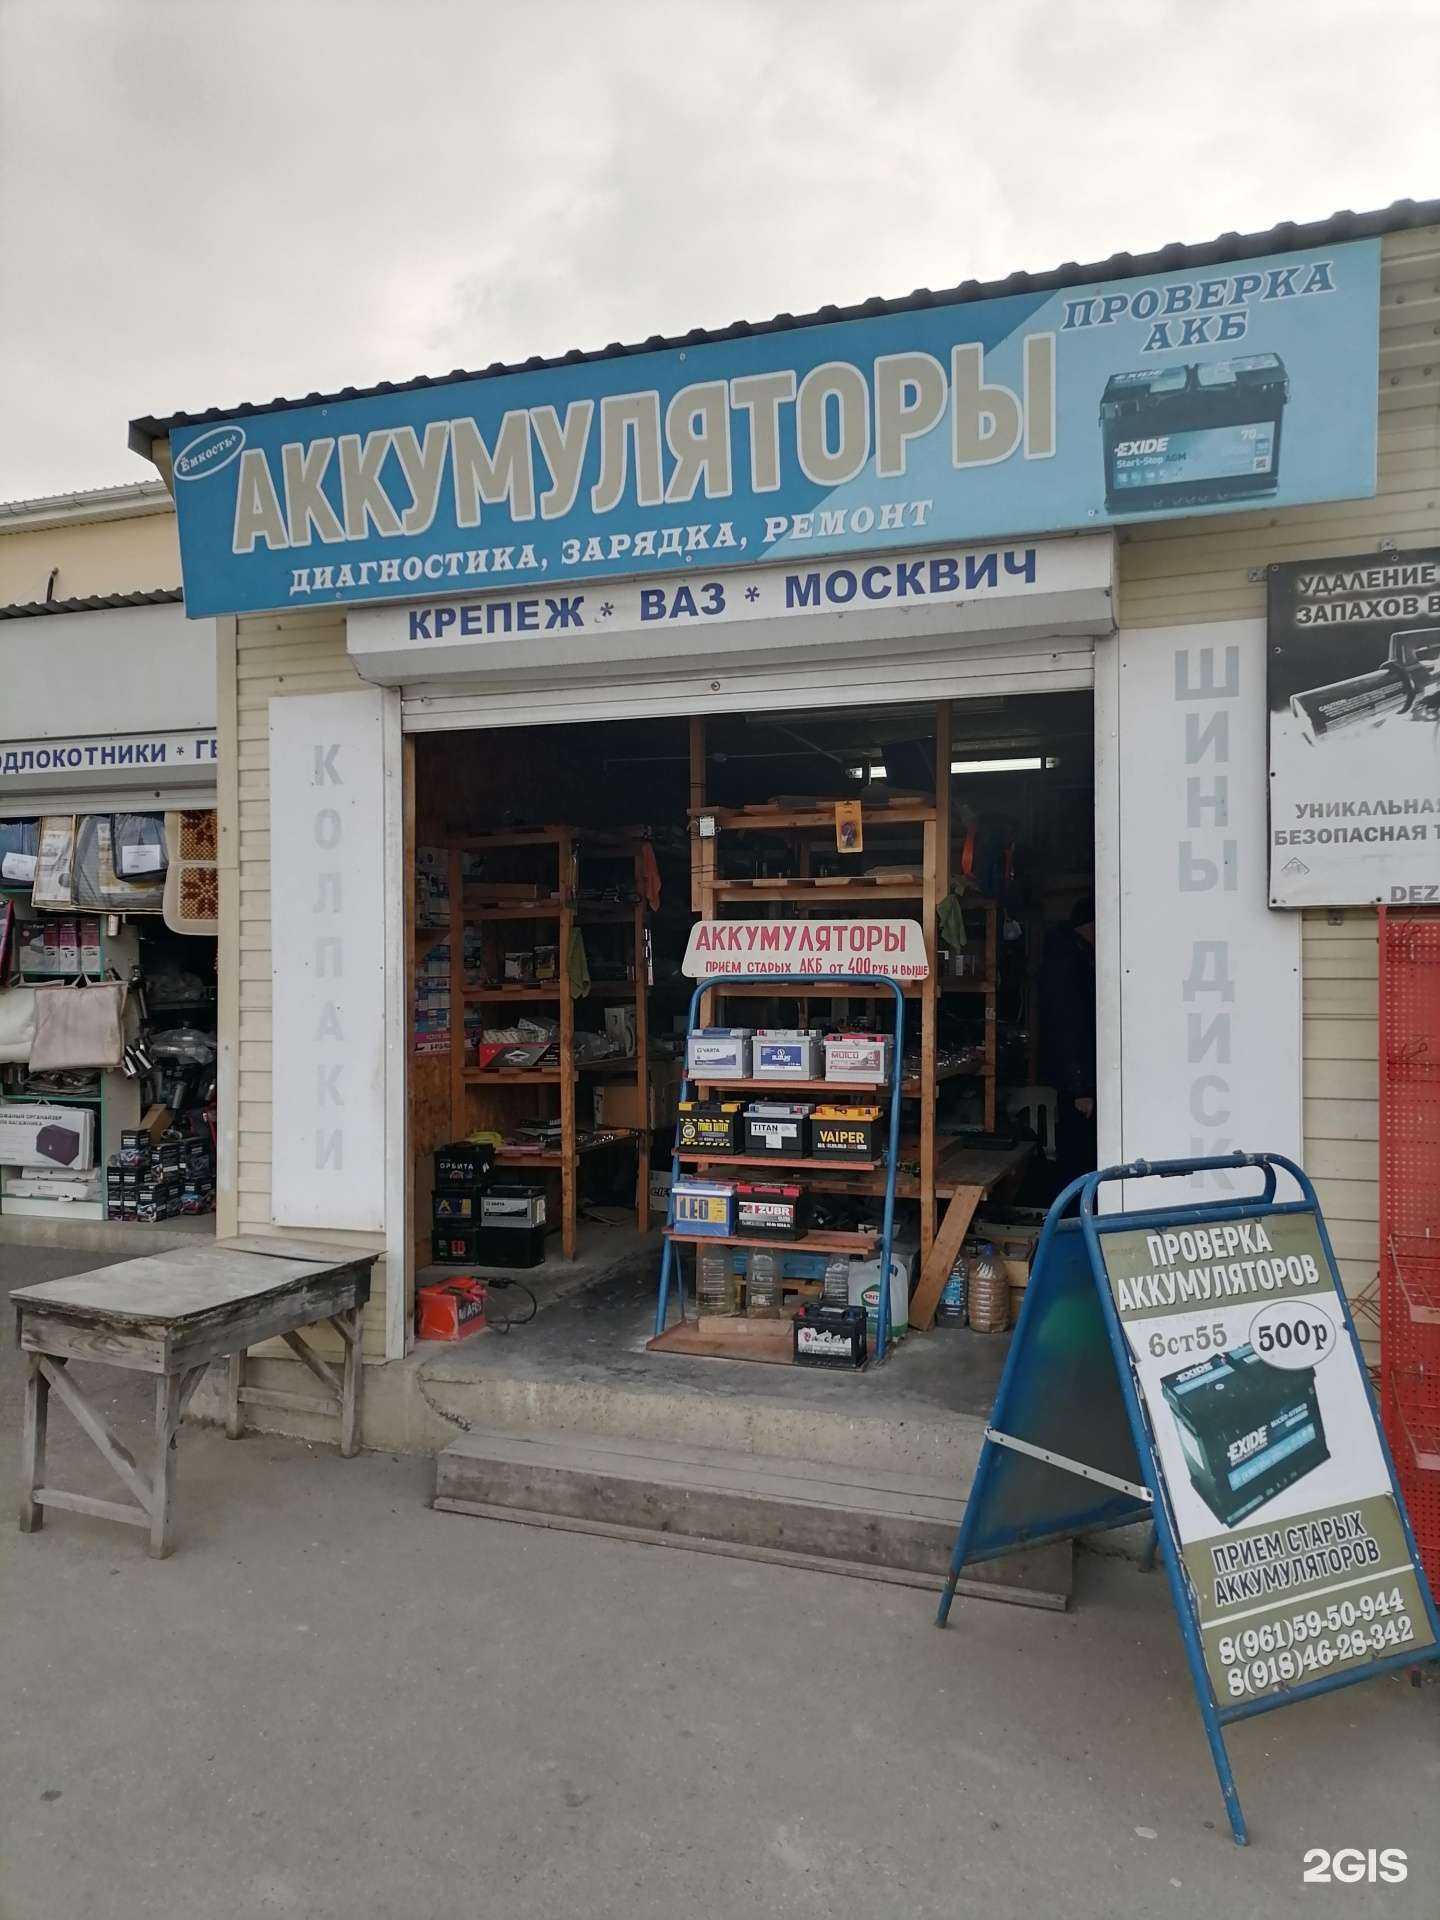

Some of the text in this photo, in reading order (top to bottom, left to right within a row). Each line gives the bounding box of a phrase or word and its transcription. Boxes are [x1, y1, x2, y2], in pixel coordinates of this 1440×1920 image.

[1061, 261, 1336, 330] ПРОВЕРКА
[1141, 311, 1249, 353] АКБ
[232, 332, 1056, 554] АККУМУЛЯТОРЫ
[1114, 437, 1170, 457] EXIDE
[289, 499, 934, 597] ДИАГНОСТИКА, ЗАРЯДКА, РЕМОНТ
[408, 549, 1037, 641] КРЕПЕЖ ВАЗ МОСКВИЧ
[1299, 564, 1437, 597] УДАЛЕНИЕ
[1296, 598, 1419, 626] ЗАПАХОВ
[0, 743, 166, 775] ДЛОКОТНИКИ
[1174, 645, 1240, 893] ШИНЫ
[1295, 798, 1440, 820] УНИКАЛЬНА
[1274, 825, 1427, 847] БЕЗОПАСНАЯ
[1390, 885, 1440, 903] DEZ
[695, 926, 906, 952] АККУМУЛЯТОРЫ
[312, 743, 345, 1172] КОЛПАКИ
[705, 961, 741, 973] ПРИЕМ
[747, 961, 791, 974] СТАРЫХ
[800, 957, 822, 974] АКБ
[848, 957, 870, 974] 400
[900, 965, 928, 977] ВЫШЕ
[753, 1123, 778, 1132] TITAN
[819, 1130, 865, 1144] VAIPER
[1147, 1224, 1273, 1267] ПРОВЕРКА
[1118, 1254, 1319, 1312] АККУМУЛЯТОРОВ
[1149, 1323, 1227, 1358] 6ст55
[1258, 1319, 1328, 1352] 500р
[1227, 1425, 1268, 1461] EXIDE
[1211, 1510, 1366, 1575] ПРИЕМ СТАРЫХ
[1214, 1538, 1381, 1608] АККУМУЛЯТОРОВ
[1218, 1587, 1406, 1666] 8(961)59-50-944
[1227, 1615, 1414, 1697] 8(918)46-28-342
